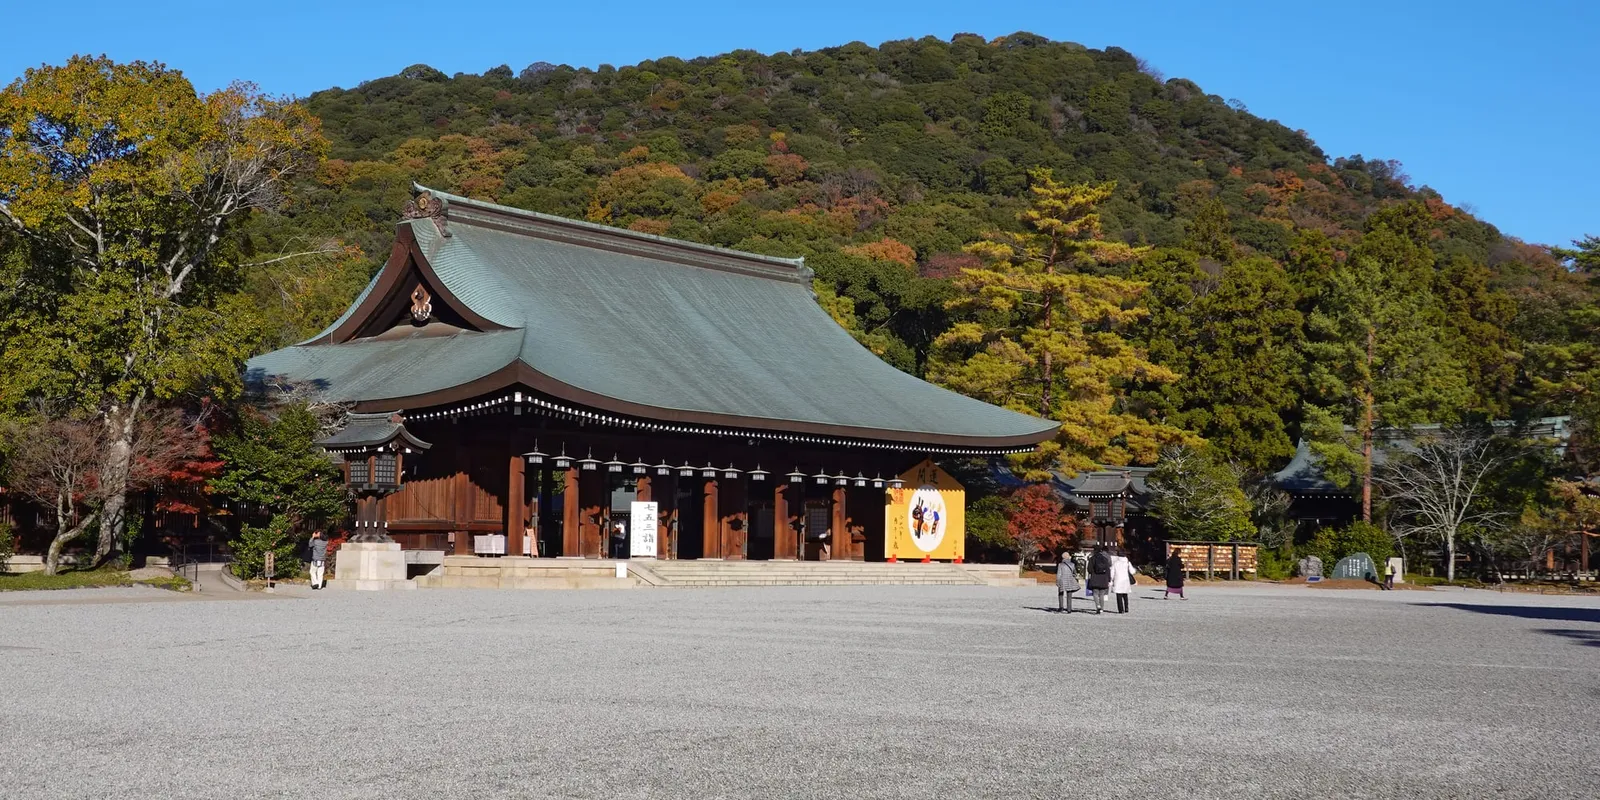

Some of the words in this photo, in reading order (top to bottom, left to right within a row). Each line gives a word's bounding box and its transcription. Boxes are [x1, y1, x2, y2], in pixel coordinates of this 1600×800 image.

[642, 503, 656, 552] 七五三詣り
